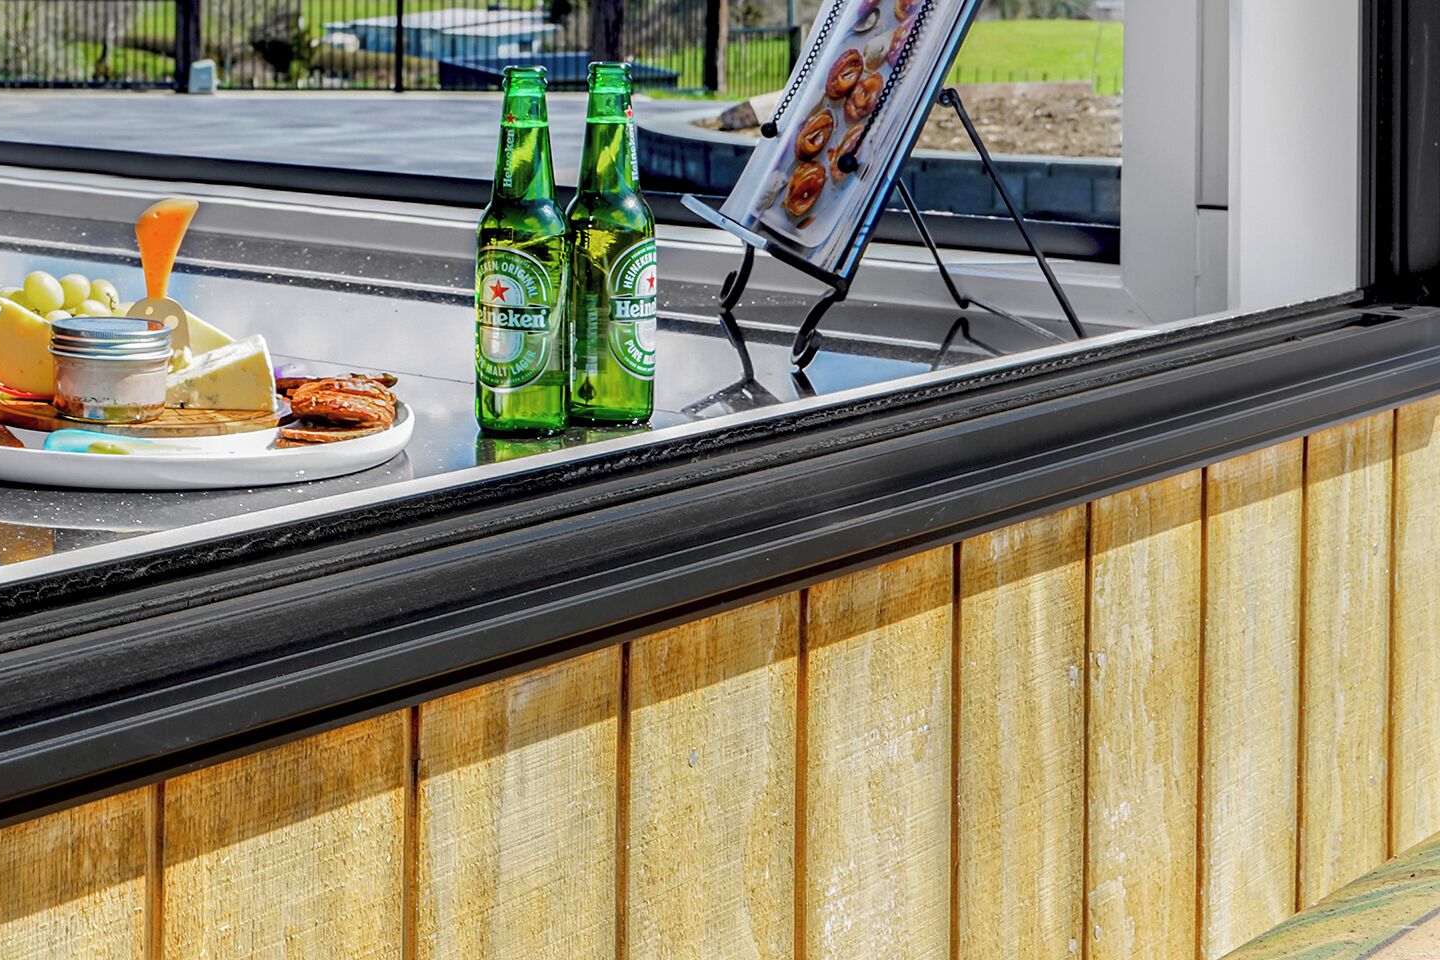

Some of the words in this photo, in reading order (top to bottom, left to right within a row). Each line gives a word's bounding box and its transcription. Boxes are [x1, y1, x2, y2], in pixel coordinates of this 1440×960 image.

[503, 129, 515, 188] Heineken
[626, 121, 639, 181] Heineken
[501, 261, 539, 298] ORIGINAL
[476, 306, 546, 328] eineken
[485, 362, 507, 377] MALT
[510, 350, 537, 375] LAGER
[624, 339, 643, 362] PURE
